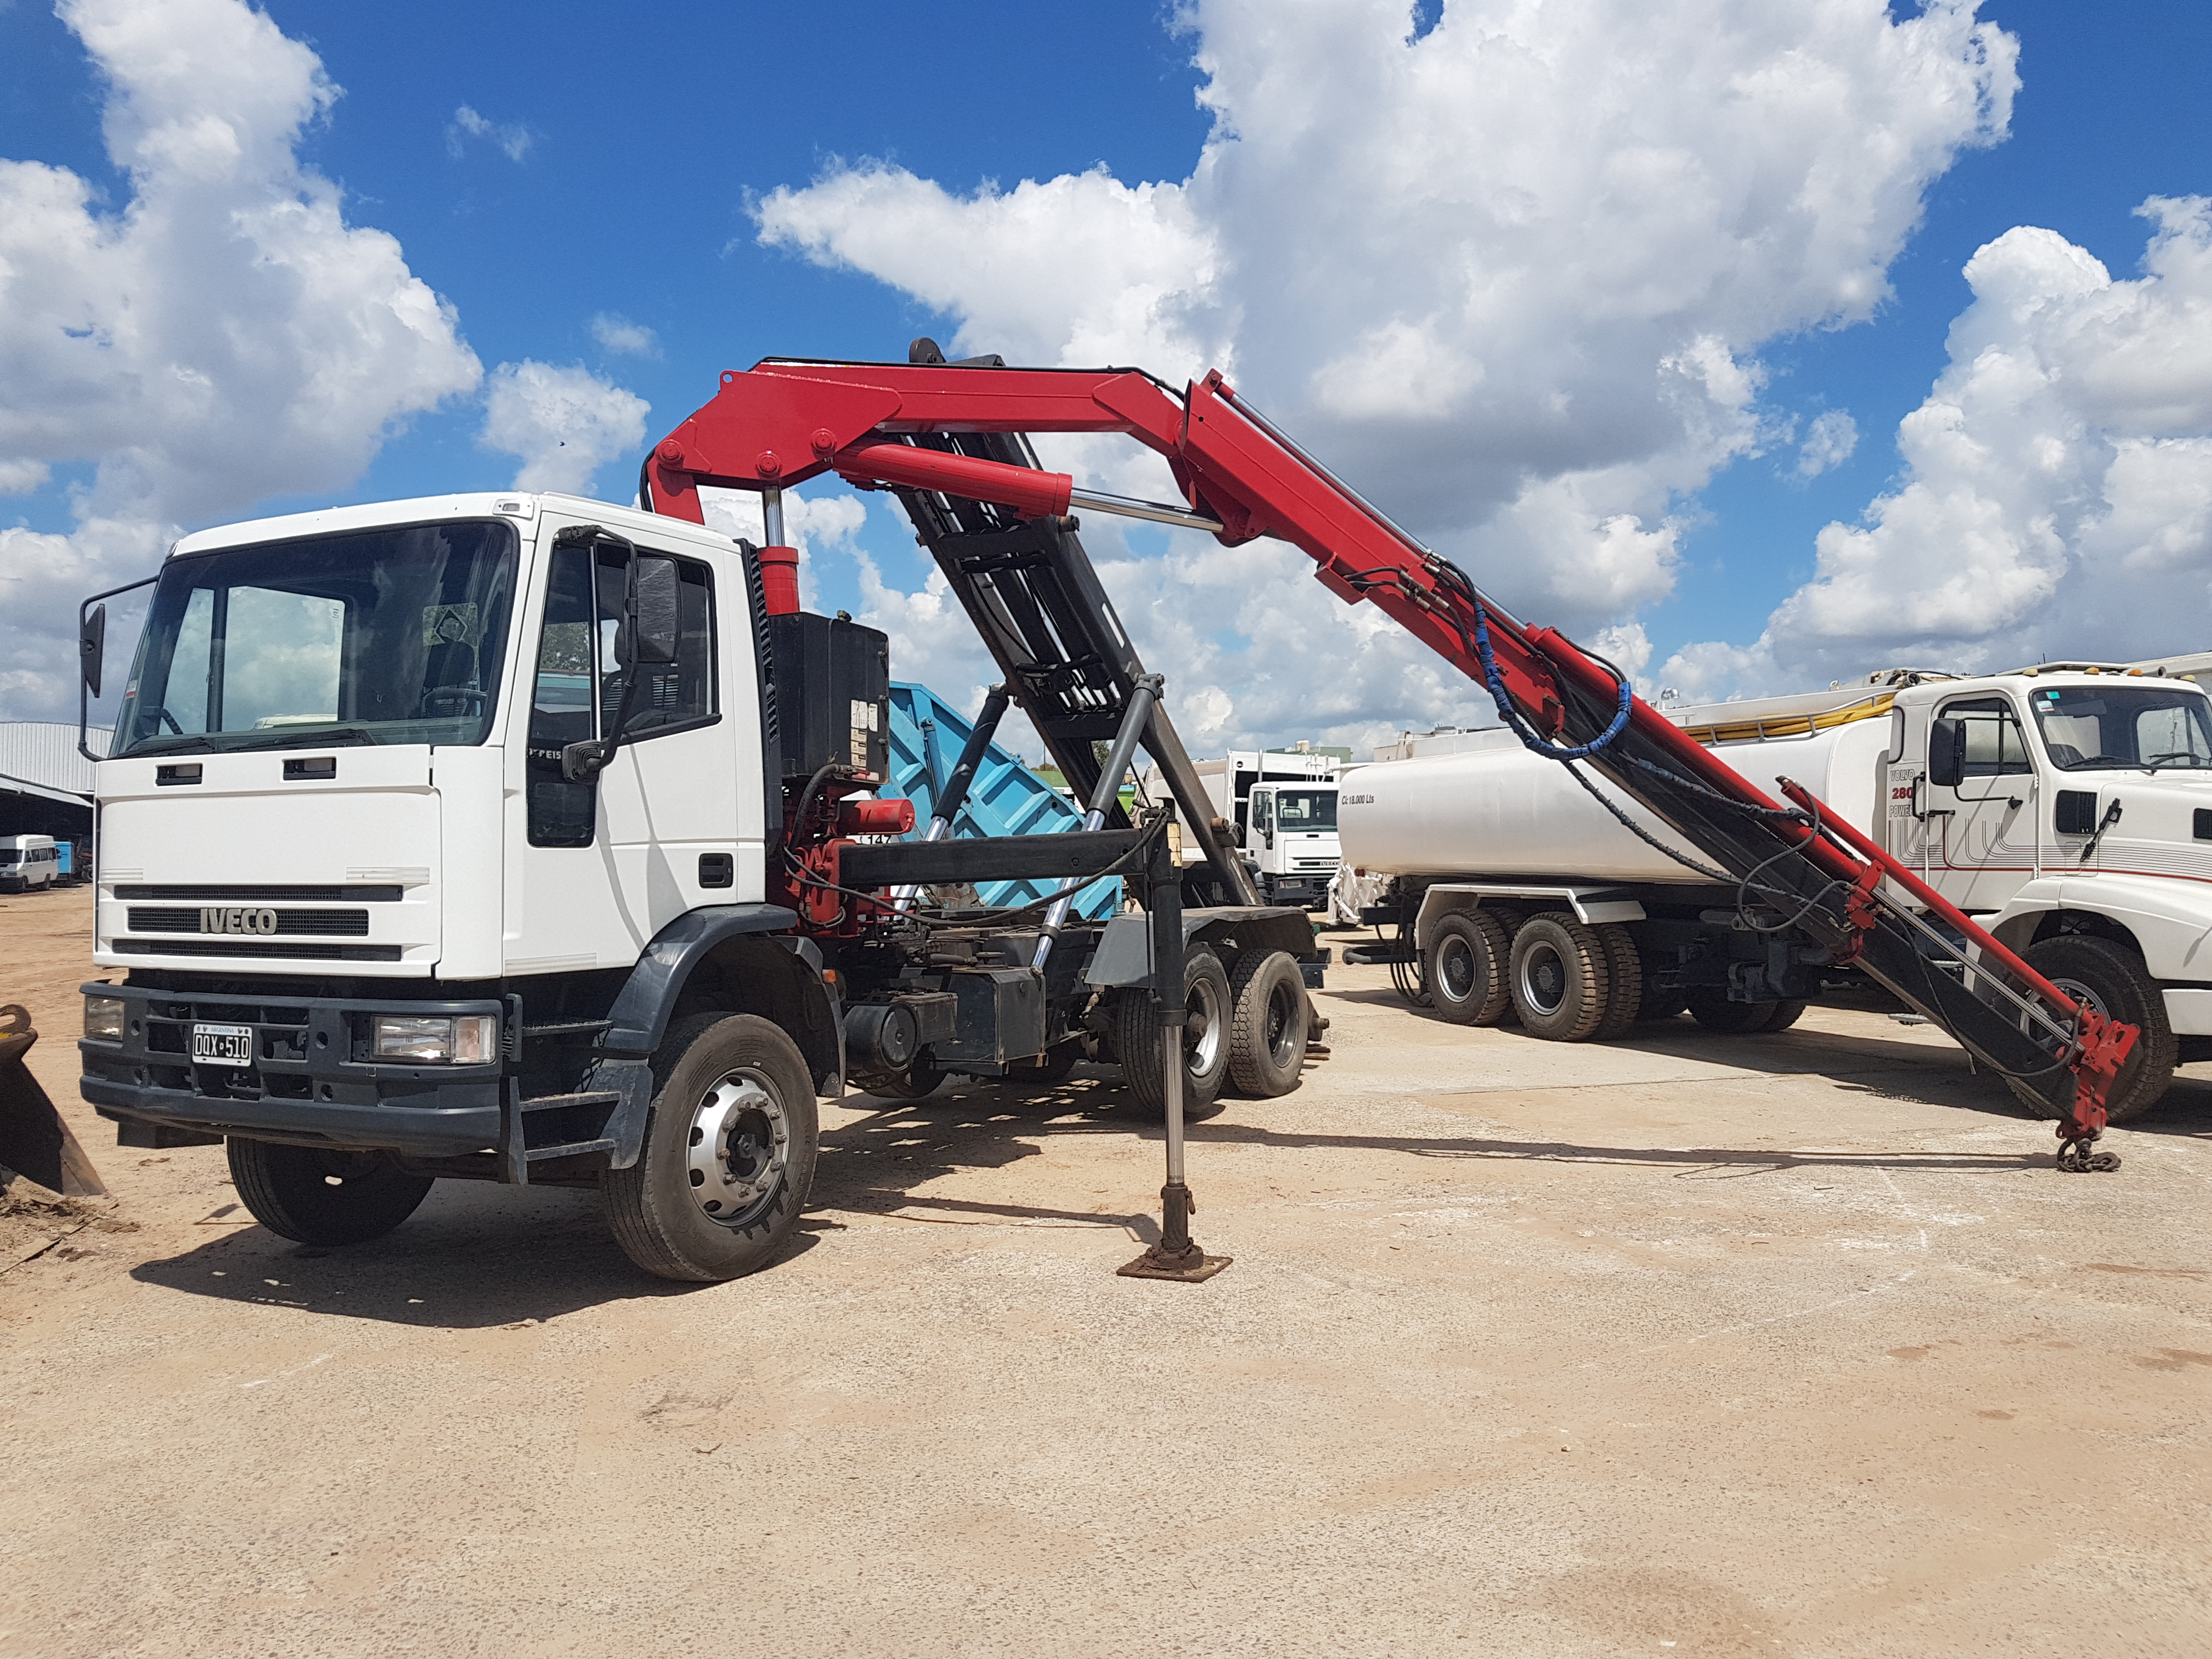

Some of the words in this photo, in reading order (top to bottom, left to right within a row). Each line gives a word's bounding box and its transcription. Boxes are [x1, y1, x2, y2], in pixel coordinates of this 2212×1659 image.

[1891, 769, 1915, 781] VOLVO
[1892, 787, 1914, 799] 280
[1349, 794, 1365, 805] 18.000
[1366, 794, 1374, 804] Lts
[868, 834, 891, 844] 147
[200, 908, 277, 935] IVECO
[195, 1034, 218, 1056] DQX
[225, 1036, 249, 1058] 510
